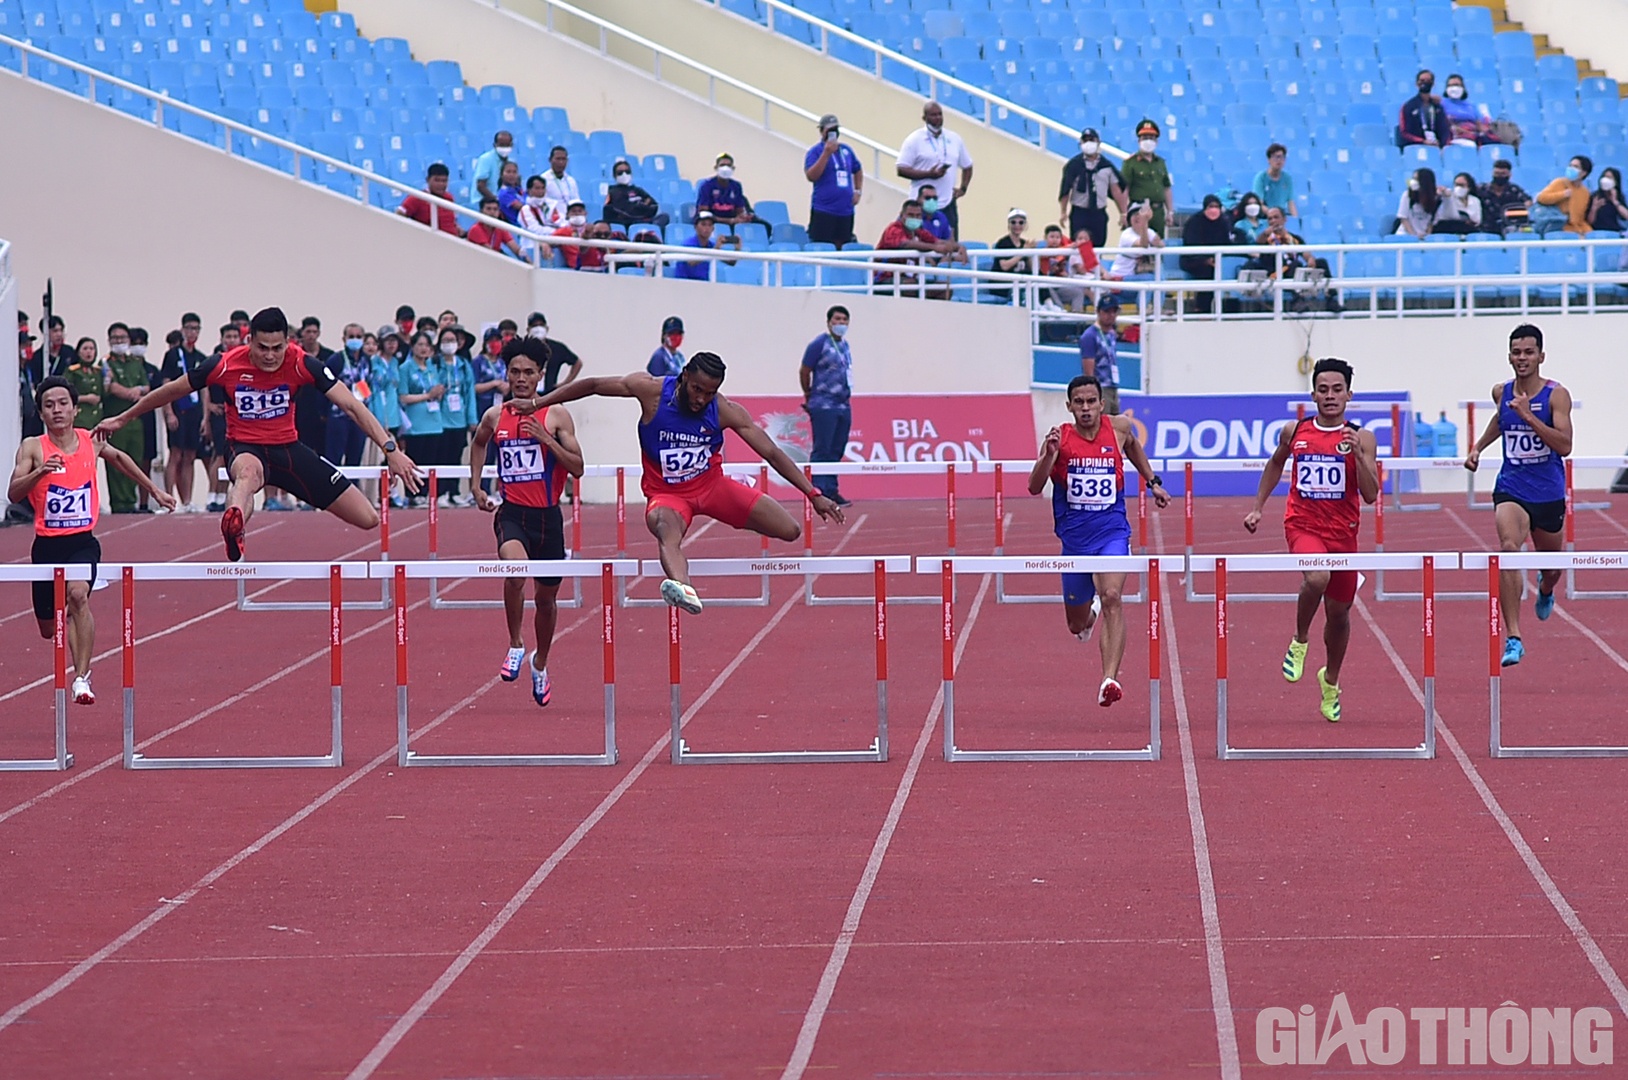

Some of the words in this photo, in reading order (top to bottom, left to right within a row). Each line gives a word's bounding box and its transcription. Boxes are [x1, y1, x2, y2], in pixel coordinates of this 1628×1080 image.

[891, 418, 939, 438] BIA
[844, 441, 990, 462] SAIGON
[1508, 434, 1545, 452] 709
[502, 449, 537, 469] 817
[1300, 466, 1341, 485] 210
[1071, 478, 1112, 497] 538
[47, 493, 87, 514] 621
[506, 565, 528, 574] Sport
[778, 562, 800, 572] Sport
[1052, 561, 1074, 570] Sport
[1326, 559, 1348, 568] Sport
[1600, 557, 1622, 566] Sport
[234, 567, 256, 576] Sport
